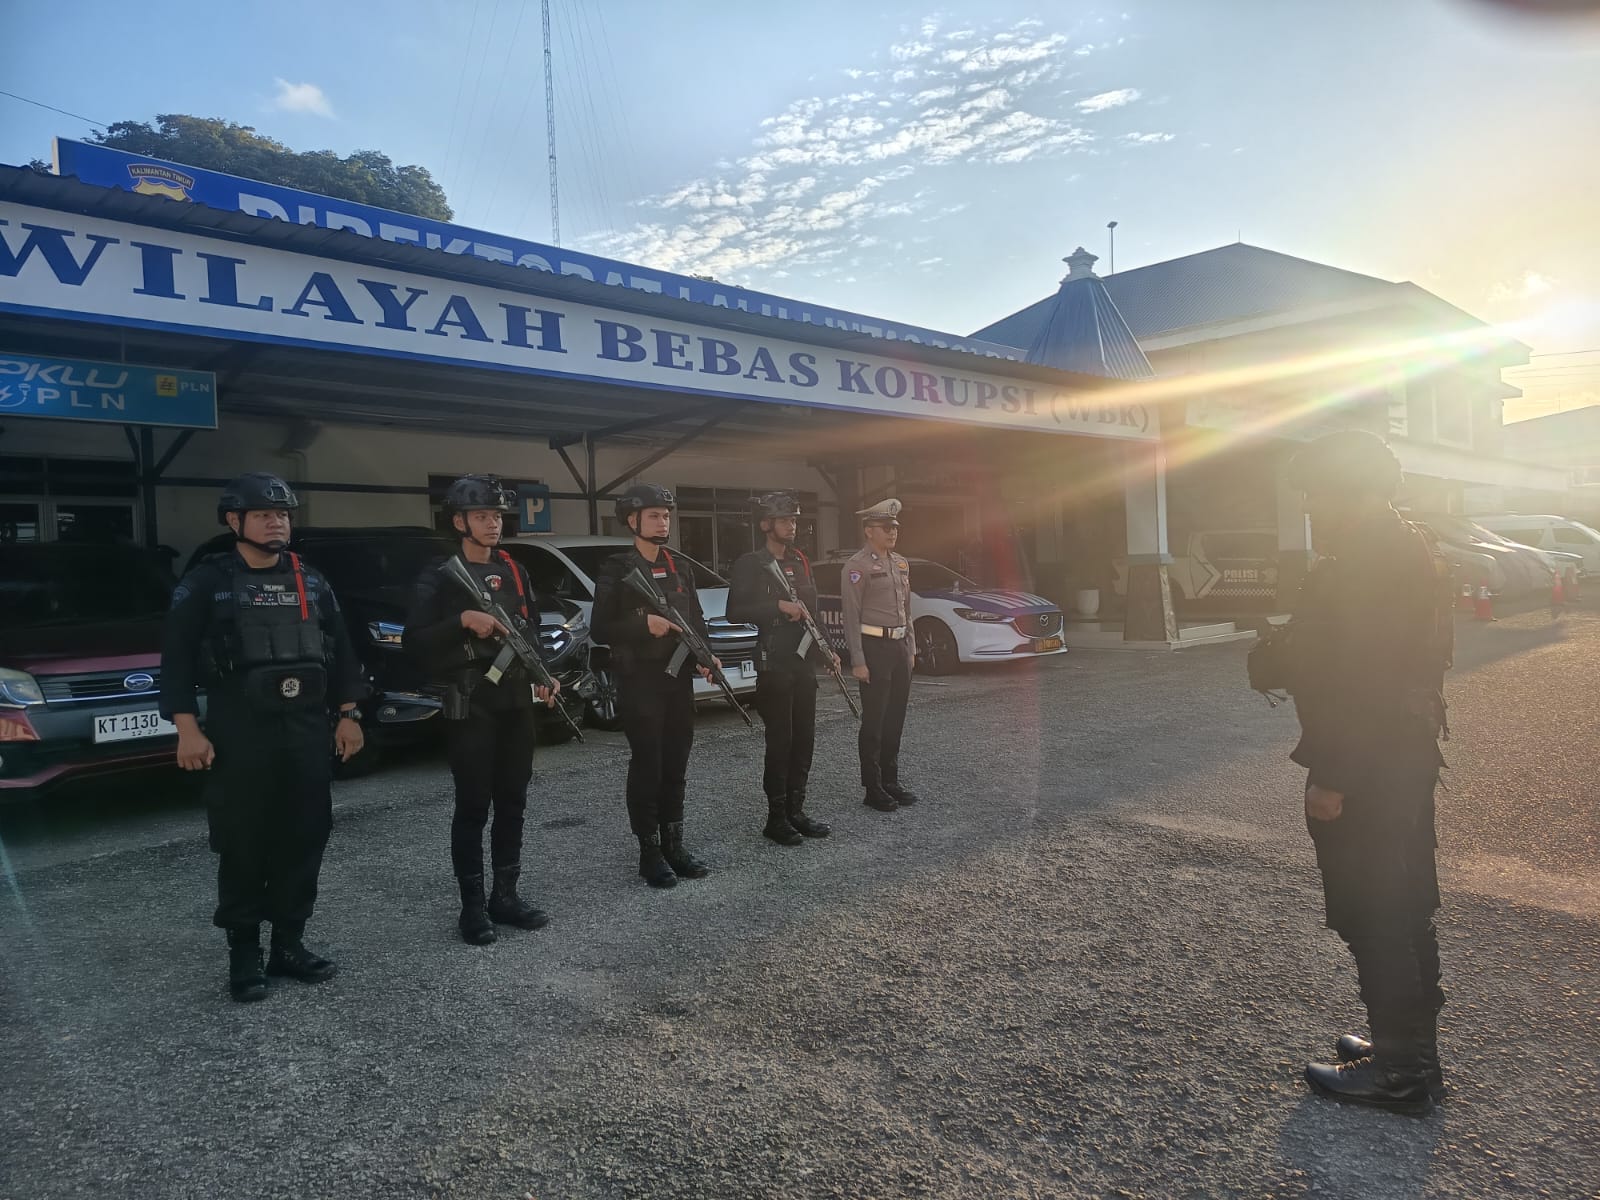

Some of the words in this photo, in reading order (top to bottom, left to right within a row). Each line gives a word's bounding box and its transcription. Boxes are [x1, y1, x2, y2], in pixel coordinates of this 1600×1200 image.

[131, 167, 171, 178] KALIMANTAN
[172, 173, 191, 185] TIMUR
[0, 219, 567, 353] WILAYAH
[594, 319, 819, 388] BEBAS
[835, 359, 1039, 416] KORUPSI
[1049, 391, 1149, 433] (WBK)
[180, 381, 210, 393] PLN
[37, 387, 125, 410] PLN
[526, 497, 545, 525] P
[1223, 568, 1258, 579] POLISI
[98, 717, 117, 734] KT
[121, 713, 159, 732] 1130
